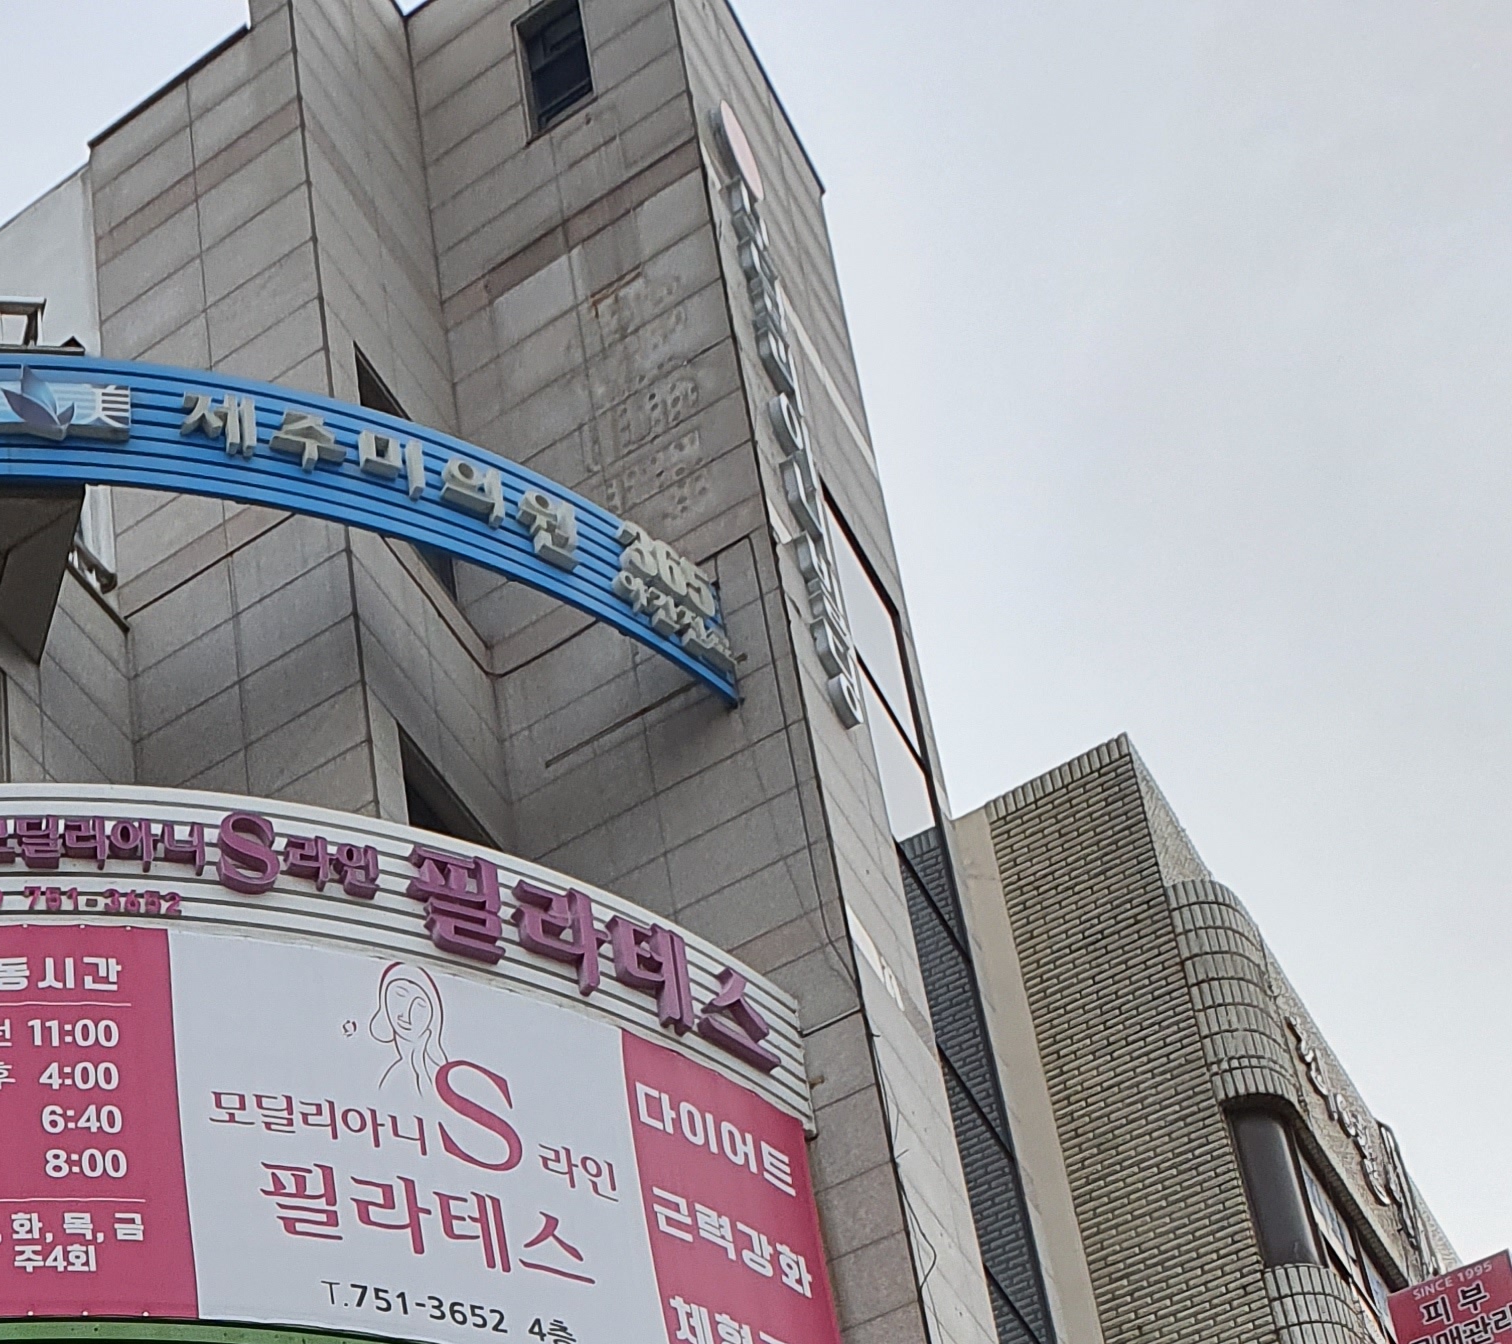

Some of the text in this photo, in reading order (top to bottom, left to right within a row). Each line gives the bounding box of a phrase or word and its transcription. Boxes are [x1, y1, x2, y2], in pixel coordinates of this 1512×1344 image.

[180, 391, 581, 573] 제주미의원
[615, 519, 716, 618] 365
[22, 885, 184, 918] 751-3652
[407, 843, 781, 1074] 필라테스
[28, 1019, 121, 1049] 11:00
[38, 1061, 121, 1091] 4:00
[41, 1105, 124, 1136] 6:40
[209, 1089, 430, 1159] 모딜리아니
[635, 1080, 797, 1198] 다이어트
[44, 1148, 128, 1180] 8:00
[258, 1160, 597, 1287] 필라테스
[650, 1183, 815, 1302] 근력강화
[13, 1246, 98, 1275] 주4회
[1411, 1261, 1493, 1301] SINCE 1995
[321, 1279, 509, 1335] T.751-3652
